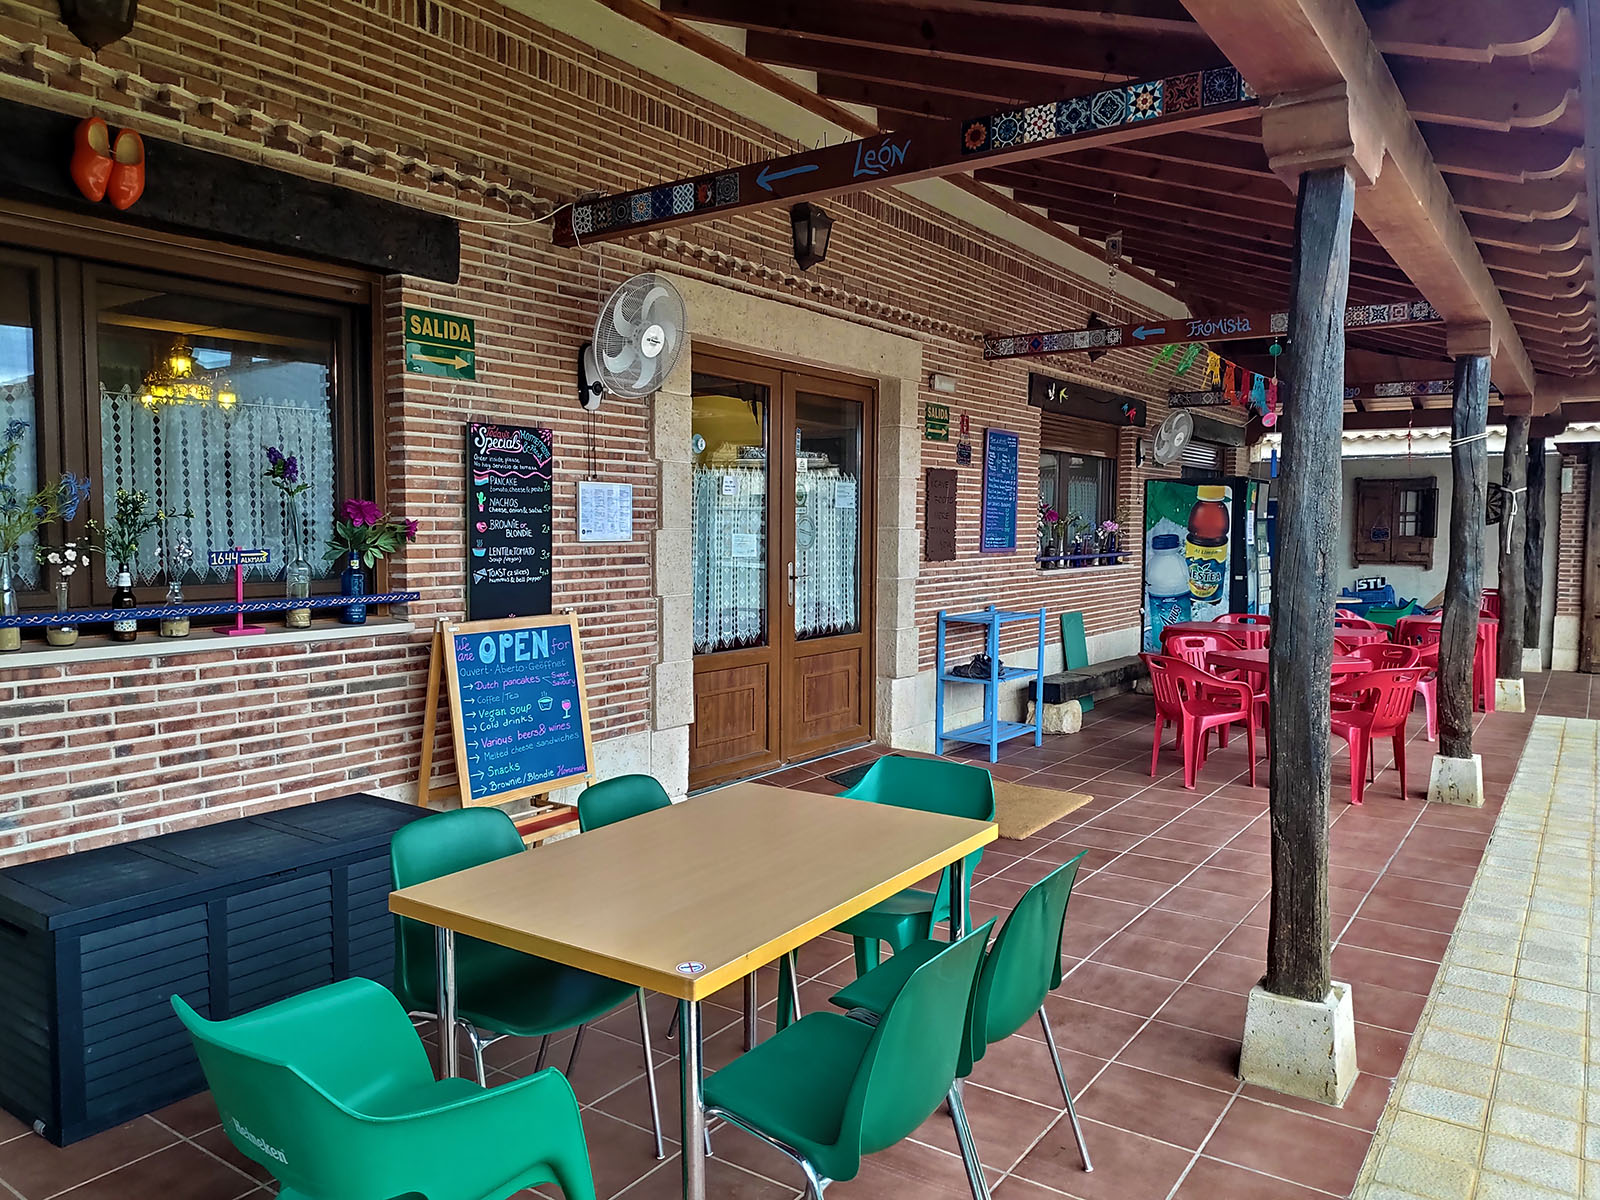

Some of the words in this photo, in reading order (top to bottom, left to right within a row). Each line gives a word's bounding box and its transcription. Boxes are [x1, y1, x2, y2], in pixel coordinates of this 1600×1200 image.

[410, 315, 471, 343] SALIDA
[927, 406, 949, 421] SALIDA
[474, 426, 521, 455] Specials
[473, 453, 488, 462] Order
[481, 461, 491, 470] hay
[489, 475, 518, 486] PANCAKE
[489, 497, 519, 508] NACHOS
[489, 519, 519, 531] BROWNIE
[505, 527, 533, 538] BLONDIE
[211, 552, 239, 565] 1644
[487, 567, 506, 578] TOAST
[455, 636, 471, 652] We
[479, 629, 549, 664] OPEN
[550, 637, 570, 656] for
[457, 652, 475, 662] are
[460, 665, 489, 677] Ouvert
[528, 658, 567, 671] Geöffnet
[474, 680, 499, 691] Dutch
[503, 675, 541, 690] pancakes
[550, 671, 570, 679] Sweet
[552, 678, 576, 688] Savoury
[478, 706, 507, 723] Vegan
[509, 703, 532, 716] soup
[479, 720, 499, 732] Cold
[502, 713, 534, 727] drinks
[480, 734, 513, 749] Various
[548, 721, 571, 732] wines
[483, 748, 509, 761] Melted
[511, 742, 534, 755] cheese
[535, 731, 580, 748] sandwiches
[487, 762, 521, 777] Snacks
[231, 1116, 289, 1165] Heineken
